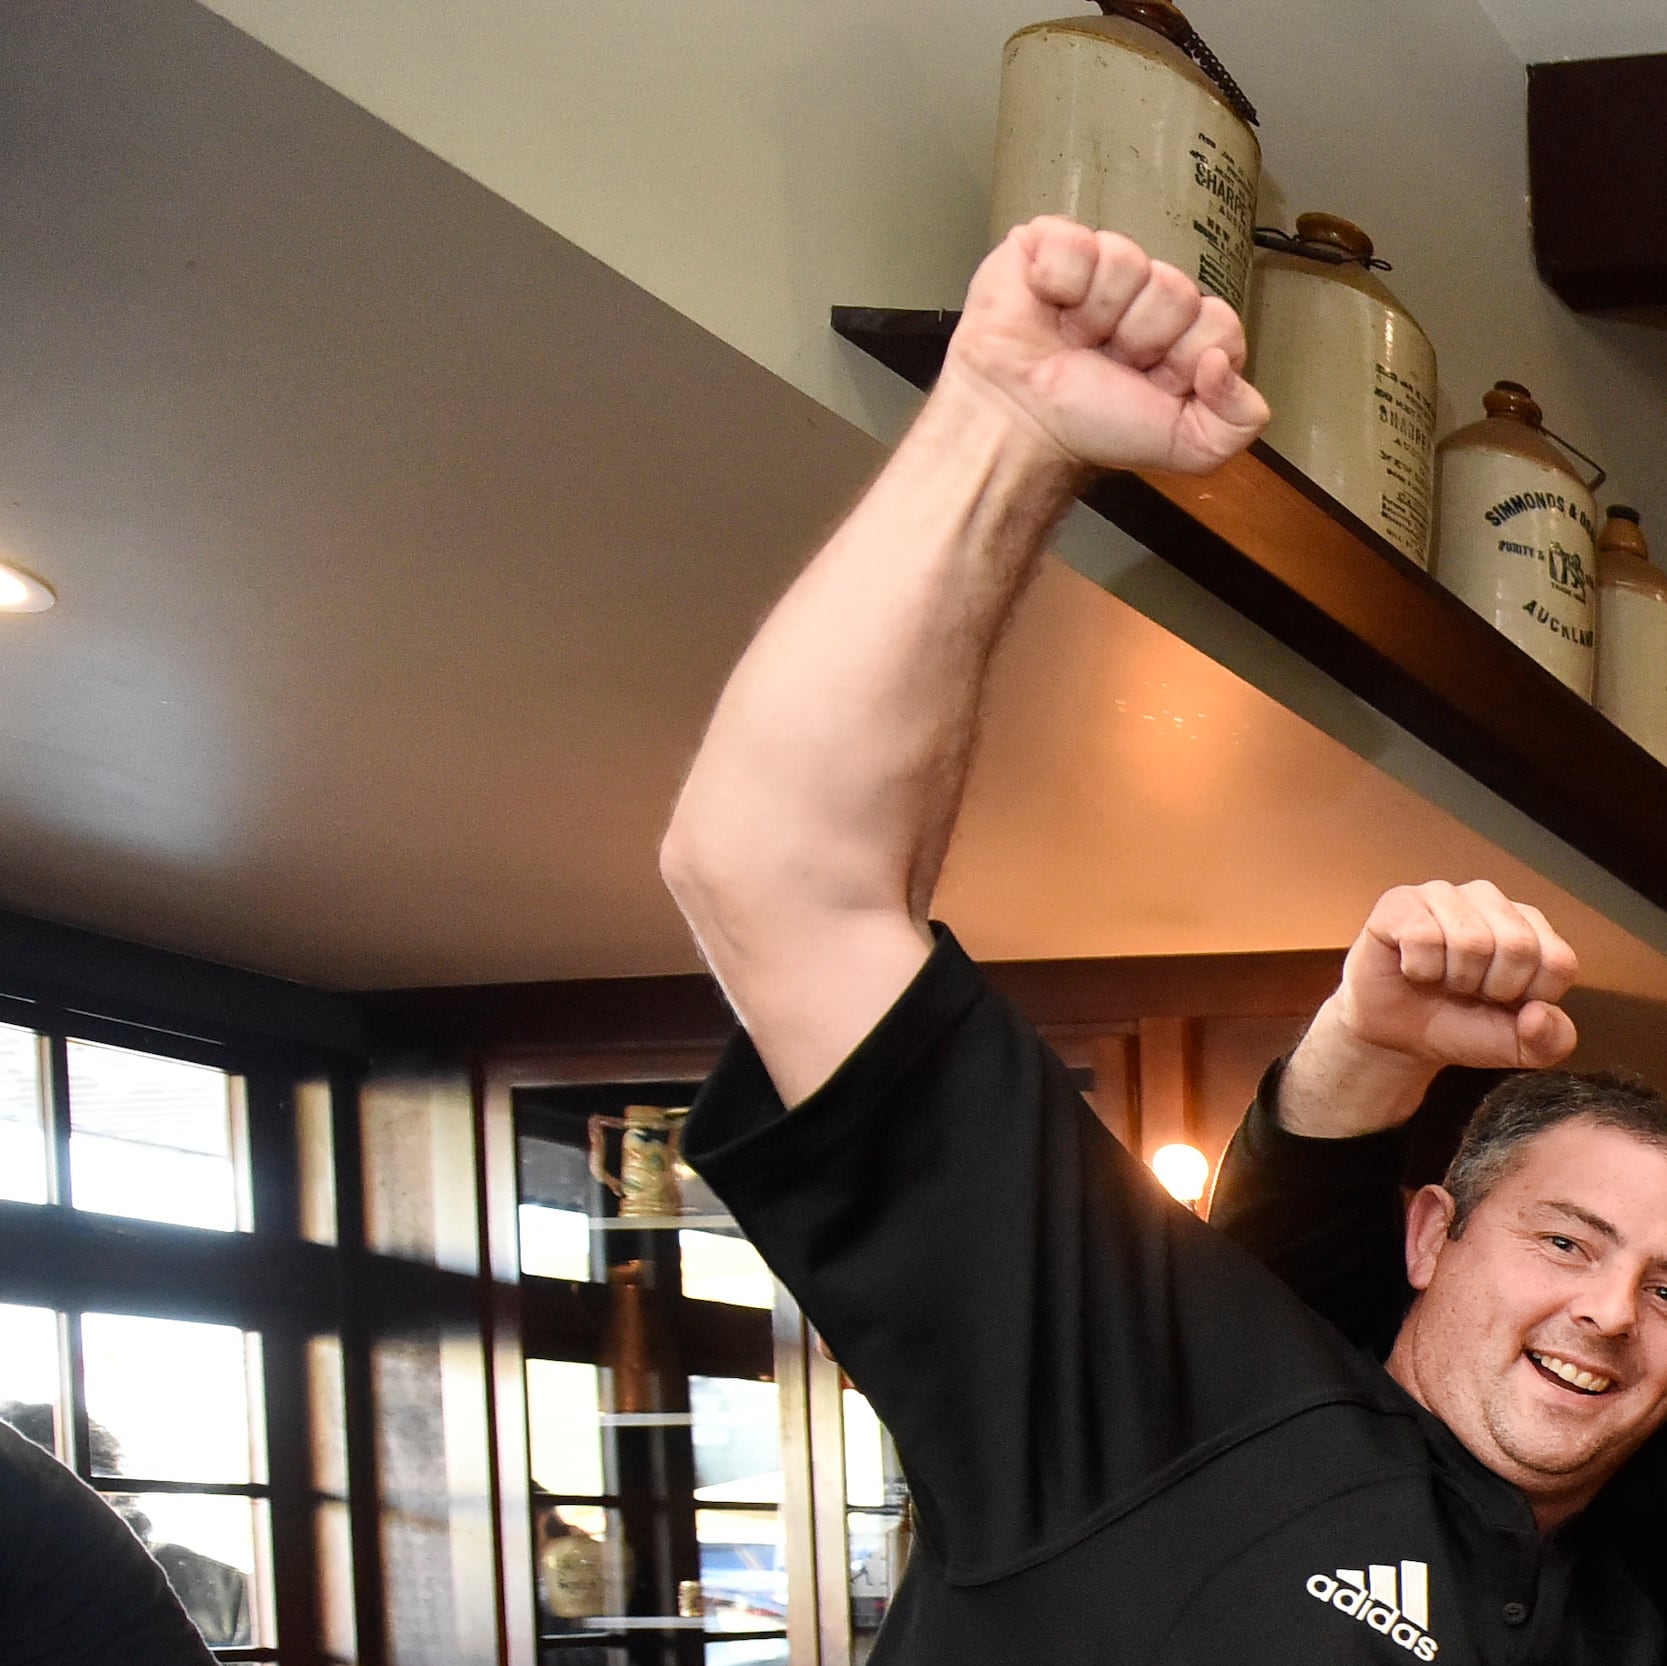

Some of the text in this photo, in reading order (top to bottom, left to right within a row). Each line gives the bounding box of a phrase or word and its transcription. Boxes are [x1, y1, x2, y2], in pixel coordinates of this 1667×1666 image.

[1485, 490, 1565, 527] SIMMONDS
[1498, 539, 1534, 558] PURITY
[1522, 599, 1594, 649] AUCKLAN
[1306, 1573, 1440, 1662] adidas
